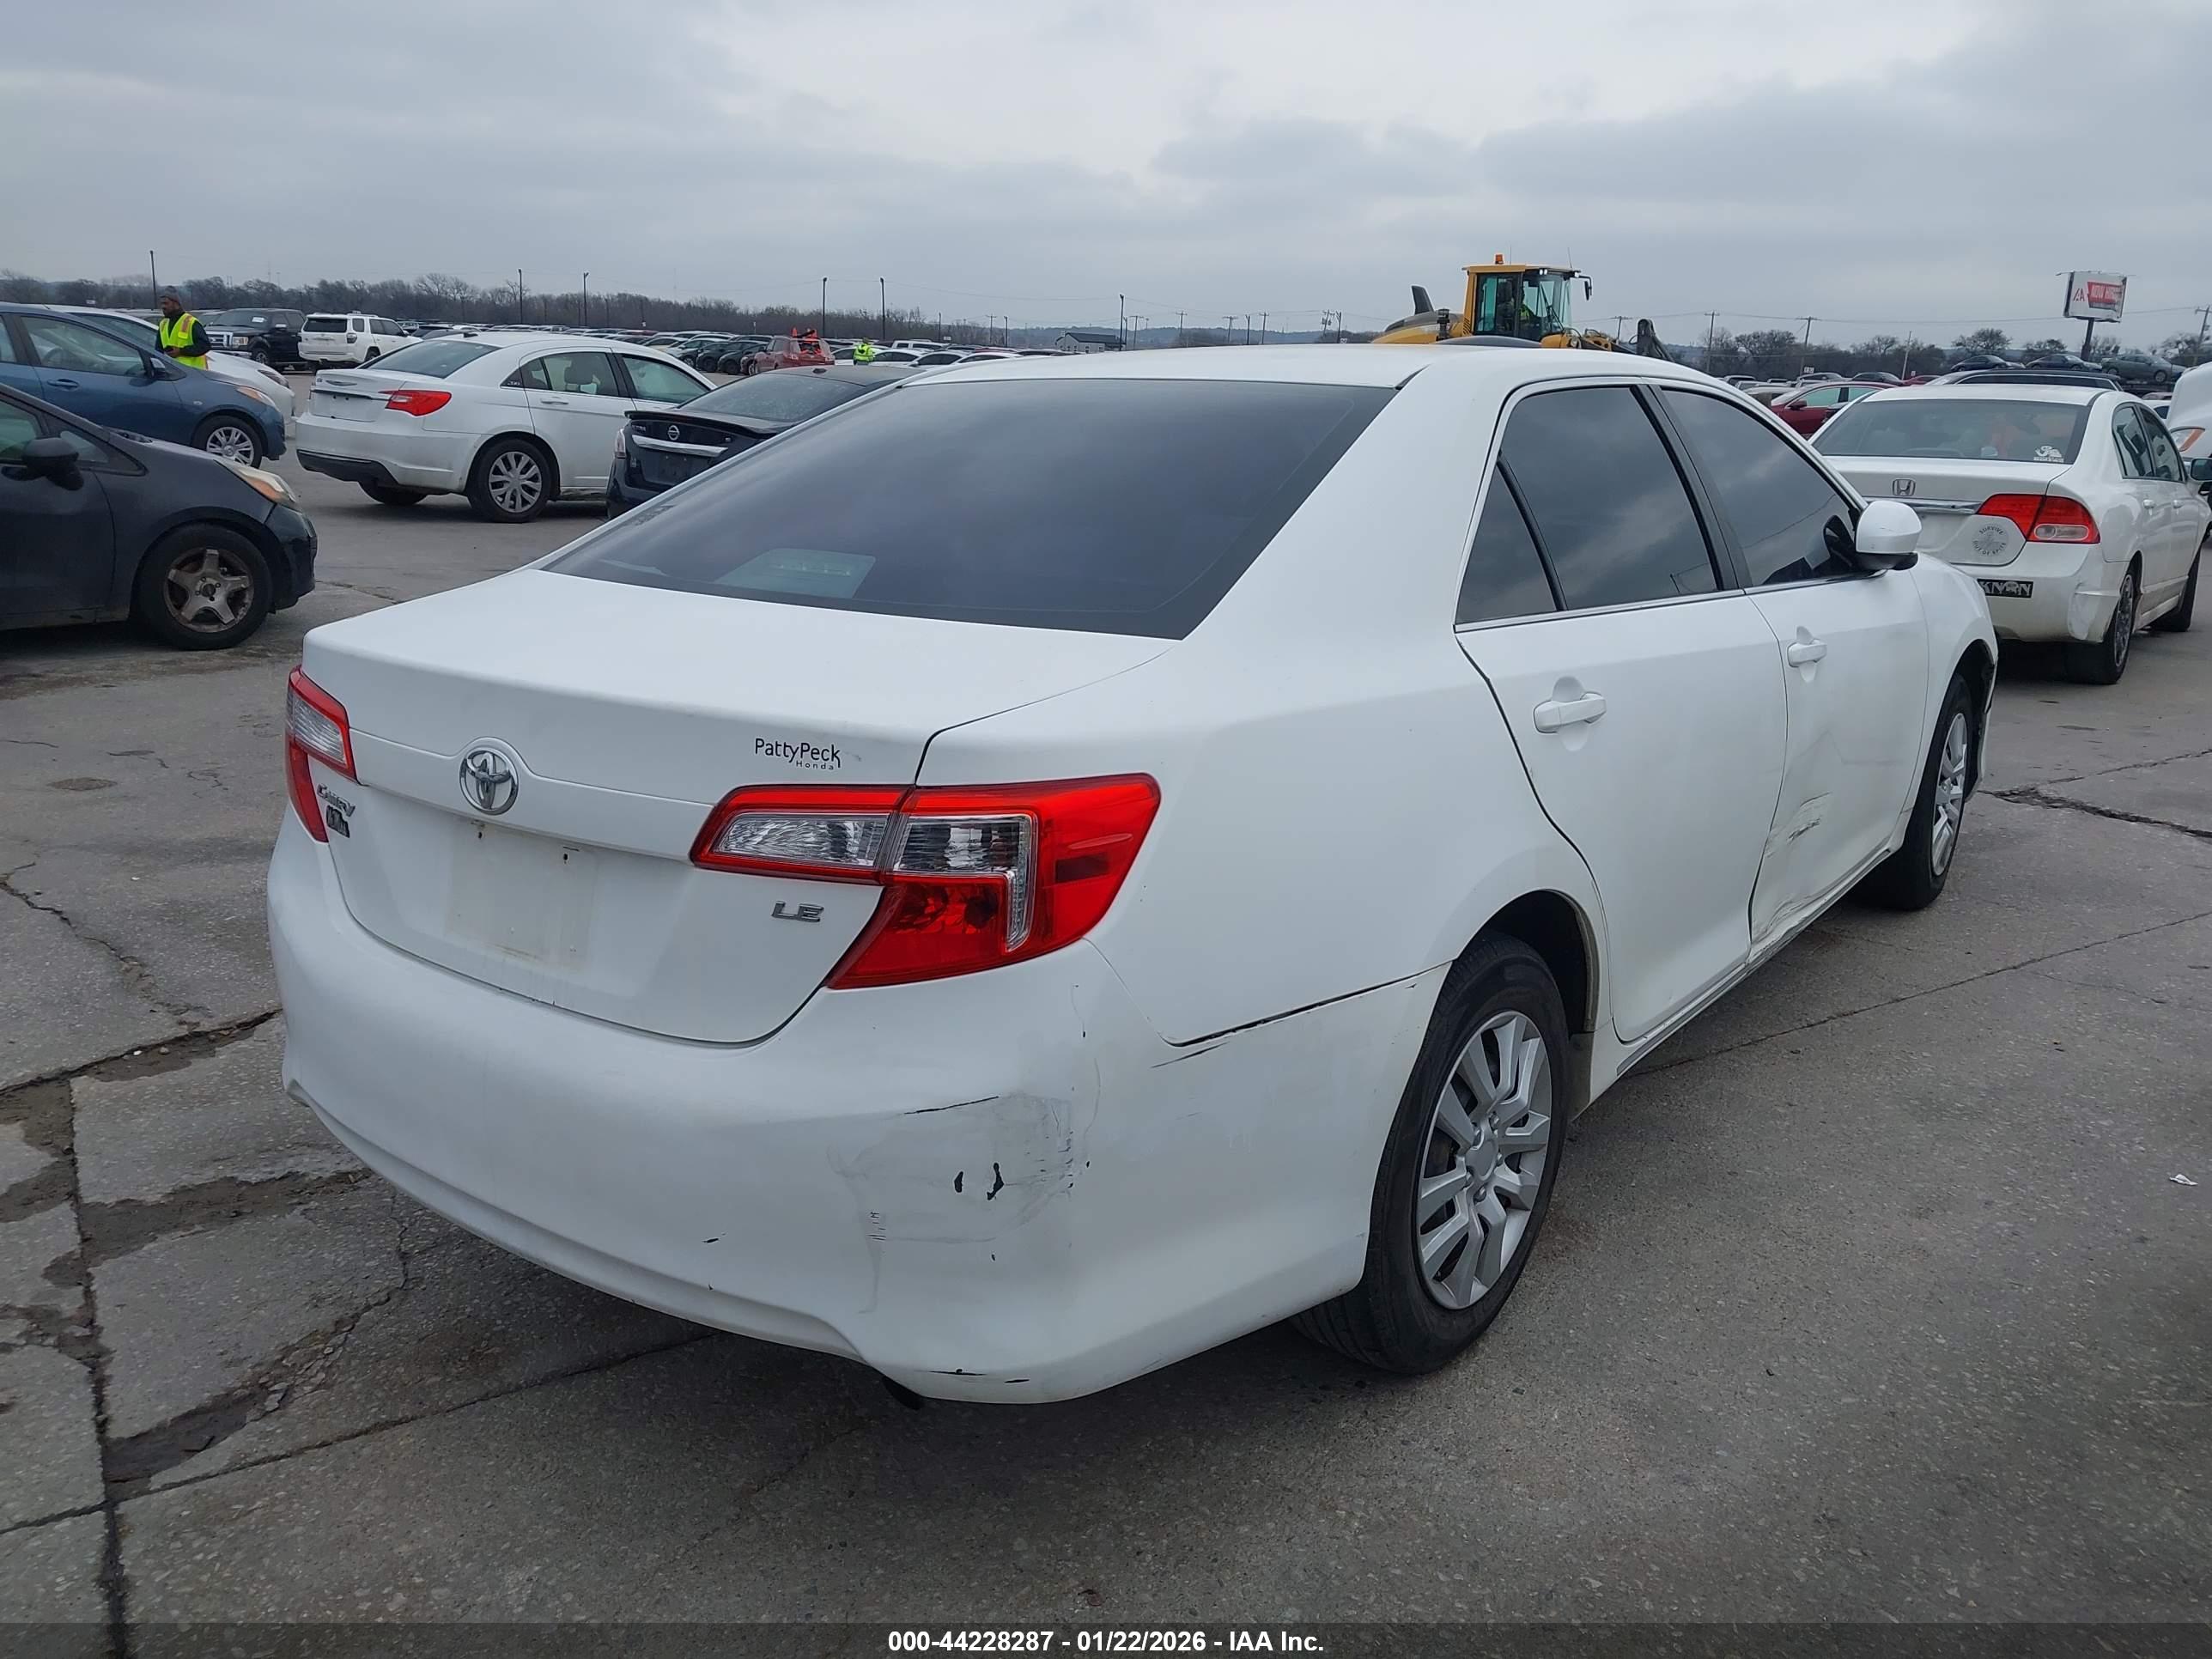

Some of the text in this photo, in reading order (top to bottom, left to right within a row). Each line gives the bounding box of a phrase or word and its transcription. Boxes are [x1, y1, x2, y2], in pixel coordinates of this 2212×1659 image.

[1978, 526, 2004, 535] SURVIVE
[755, 738, 841, 769] PattyPeck
[796, 760, 835, 770] Honda
[771, 900, 824, 923] LE
